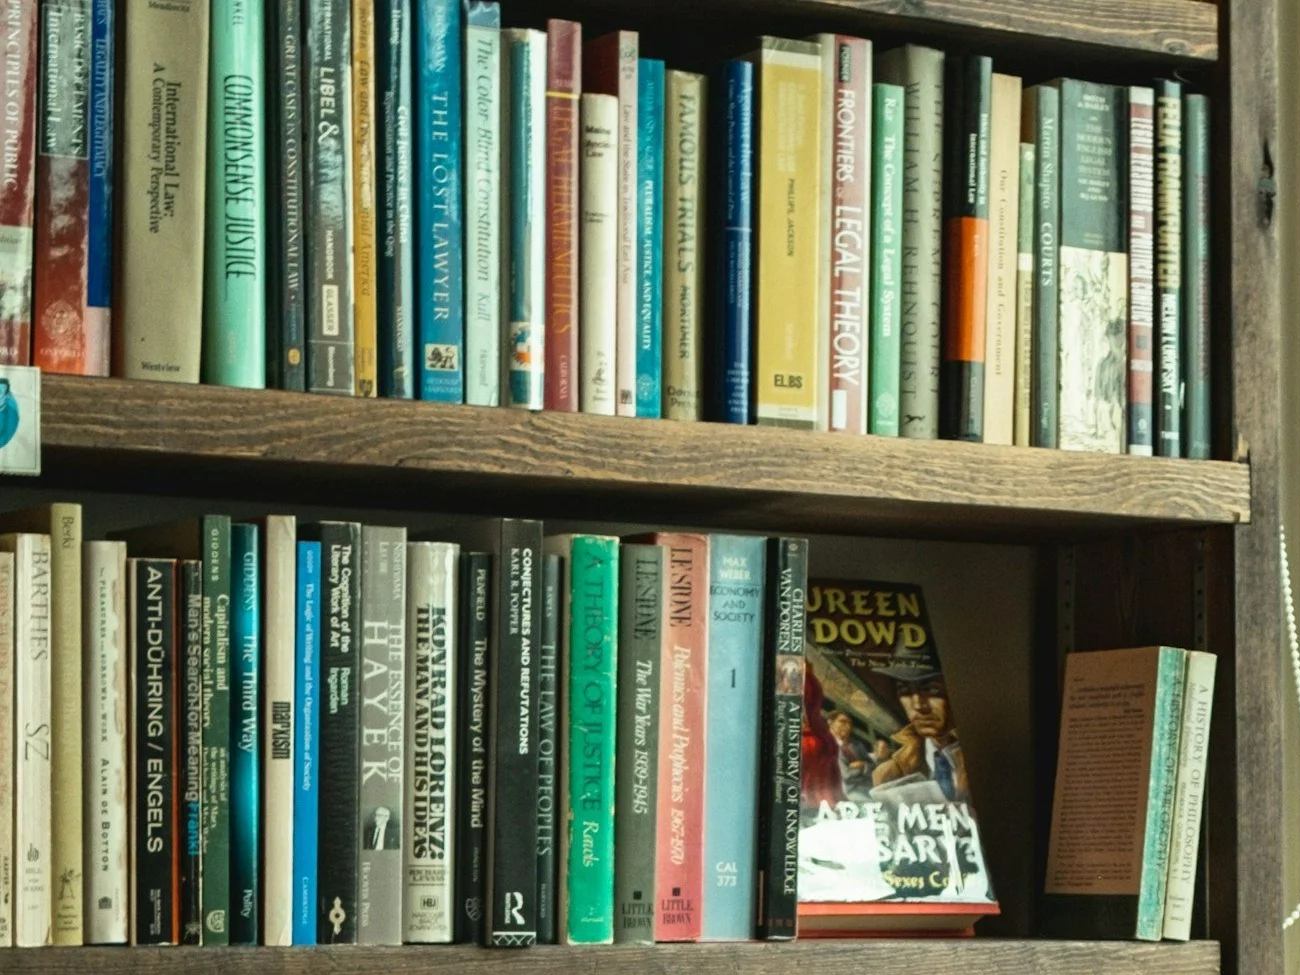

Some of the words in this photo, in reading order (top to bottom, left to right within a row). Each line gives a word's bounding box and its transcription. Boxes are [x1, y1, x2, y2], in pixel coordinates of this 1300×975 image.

[320, 67, 335, 118] LIBEL
[432, 91, 448, 142] THE
[164, 80, 182, 177] International
[224, 74, 255, 205] COMMONSENSE
[318, 121, 340, 144] &
[679, 94, 696, 186] FAMOUS
[836, 88, 856, 184] FRONTIERS
[163, 184, 180, 218] Law:
[432, 153, 449, 215] LOST
[225, 214, 256, 283] JUSTICE
[678, 196, 696, 273] TRIALS
[835, 204, 863, 277] LEGAL
[1039, 222, 1053, 286] COURTS
[432, 223, 449, 320] LAWYER
[832, 287, 860, 385] THEORY
[719, 569, 750, 579] WEBER
[723, 557, 747, 568] MAX
[780, 568, 792, 599] VAN
[31, 551, 49, 662] BARTHES
[475, 568, 487, 621] PENFIELD
[521, 548, 532, 635] CONJECTURES
[710, 586, 760, 597] ECONOMY
[723, 601, 746, 609] AND
[389, 623, 403, 661] THE
[417, 606, 430, 651] THE
[714, 612, 756, 624] SOCIETY
[779, 600, 791, 651] DOREN
[791, 588, 804, 653] CHARLES
[811, 618, 927, 648] DOWD
[147, 567, 164, 737] ANTI-DÜHRING
[416, 655, 430, 701] MAN
[431, 604, 447, 731] KONRAD
[474, 637, 487, 667] The
[521, 638, 531, 666] AND
[362, 620, 389, 785] HAYEK
[388, 670, 403, 752] ESSENCE
[414, 703, 429, 747] AND
[470, 669, 486, 736] Mystery
[519, 667, 531, 755] REFUTATIONS
[272, 702, 290, 759] marxism
[472, 737, 483, 750] of
[388, 756, 402, 783] OF
[414, 752, 428, 792] HIS
[471, 759, 484, 785] the
[147, 759, 163, 852] ENGELS
[429, 737, 446, 860] LORENZ:
[471, 788, 484, 828] Mind
[413, 795, 428, 860] IDEAS
[716, 861, 738, 873] CAL
[716, 875, 737, 887] 373
